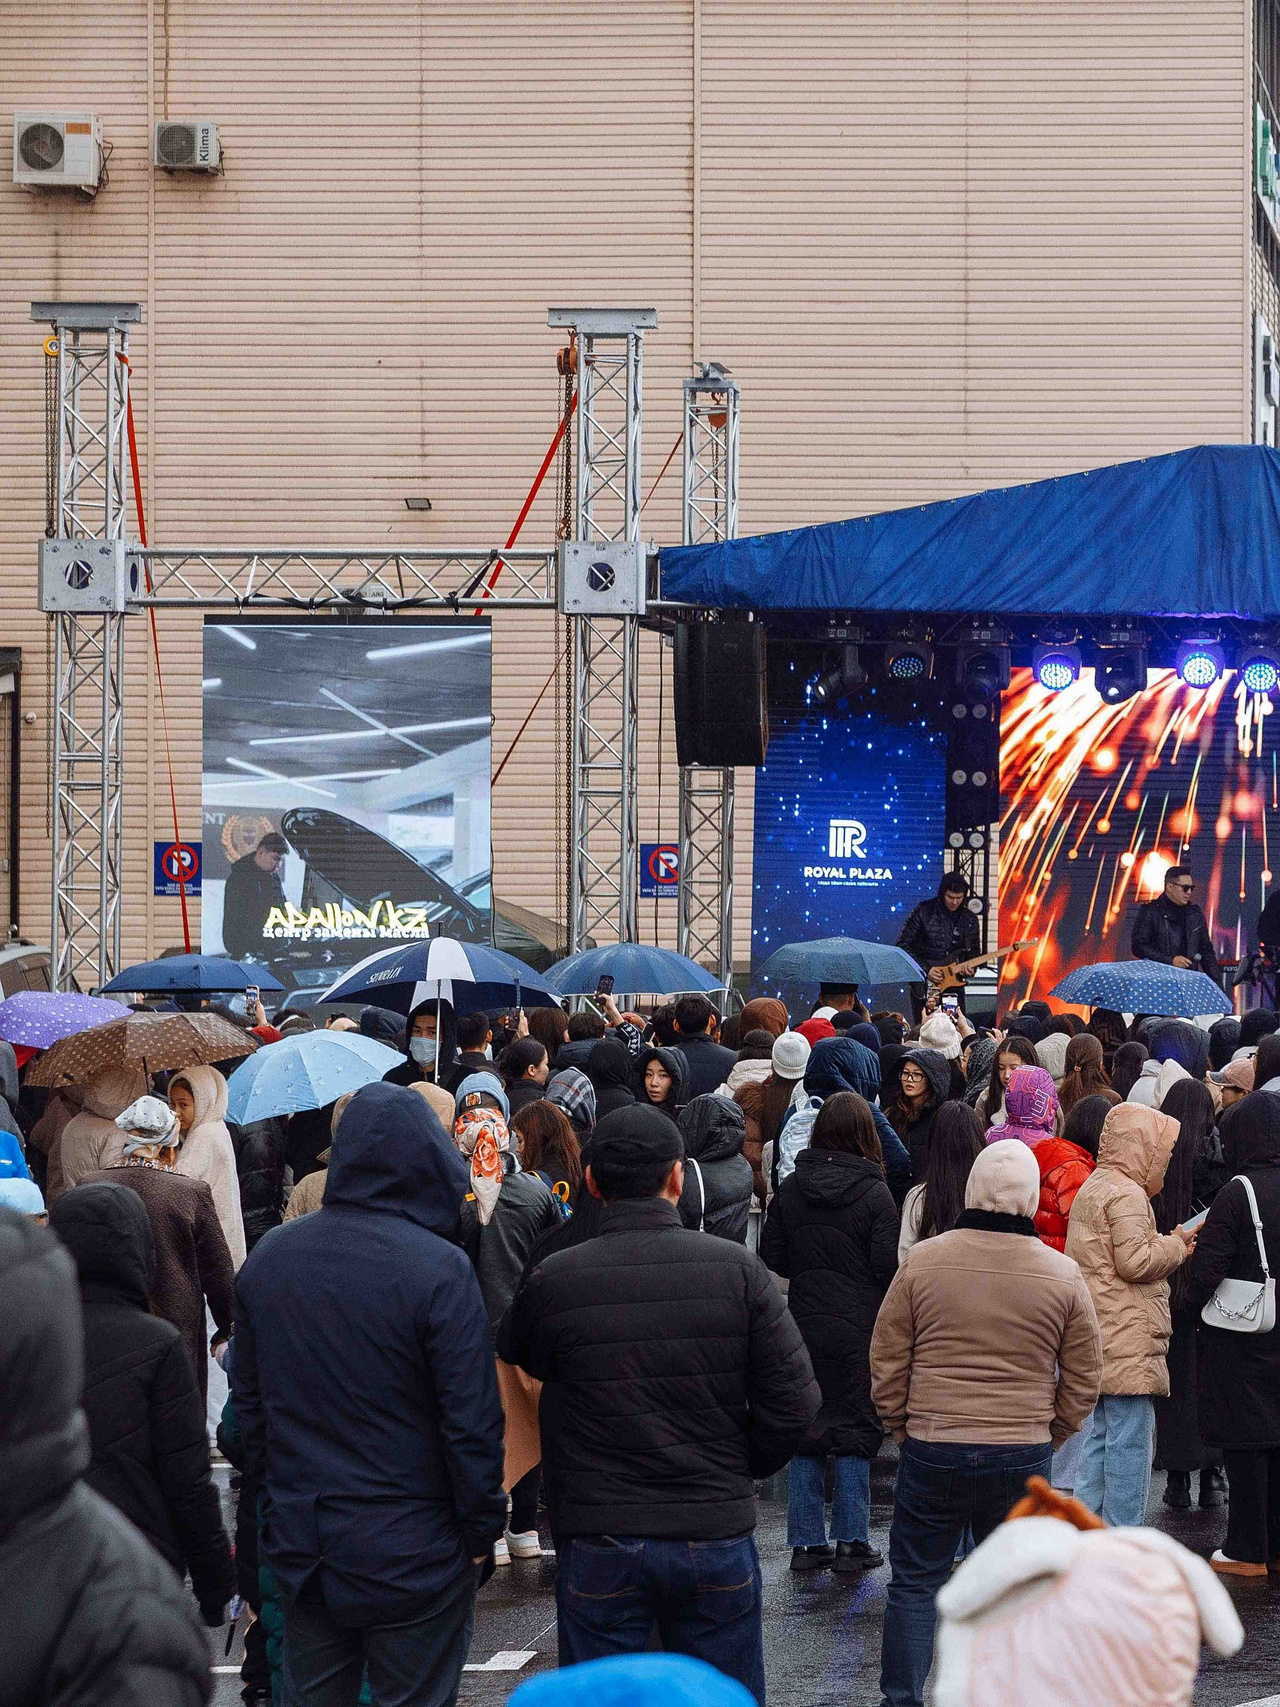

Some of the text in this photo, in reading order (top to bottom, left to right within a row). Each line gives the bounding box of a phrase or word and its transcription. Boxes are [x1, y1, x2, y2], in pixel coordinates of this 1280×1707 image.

[199, 128, 209, 162] Klima
[803, 866, 893, 880] ROYAL PLAZA
